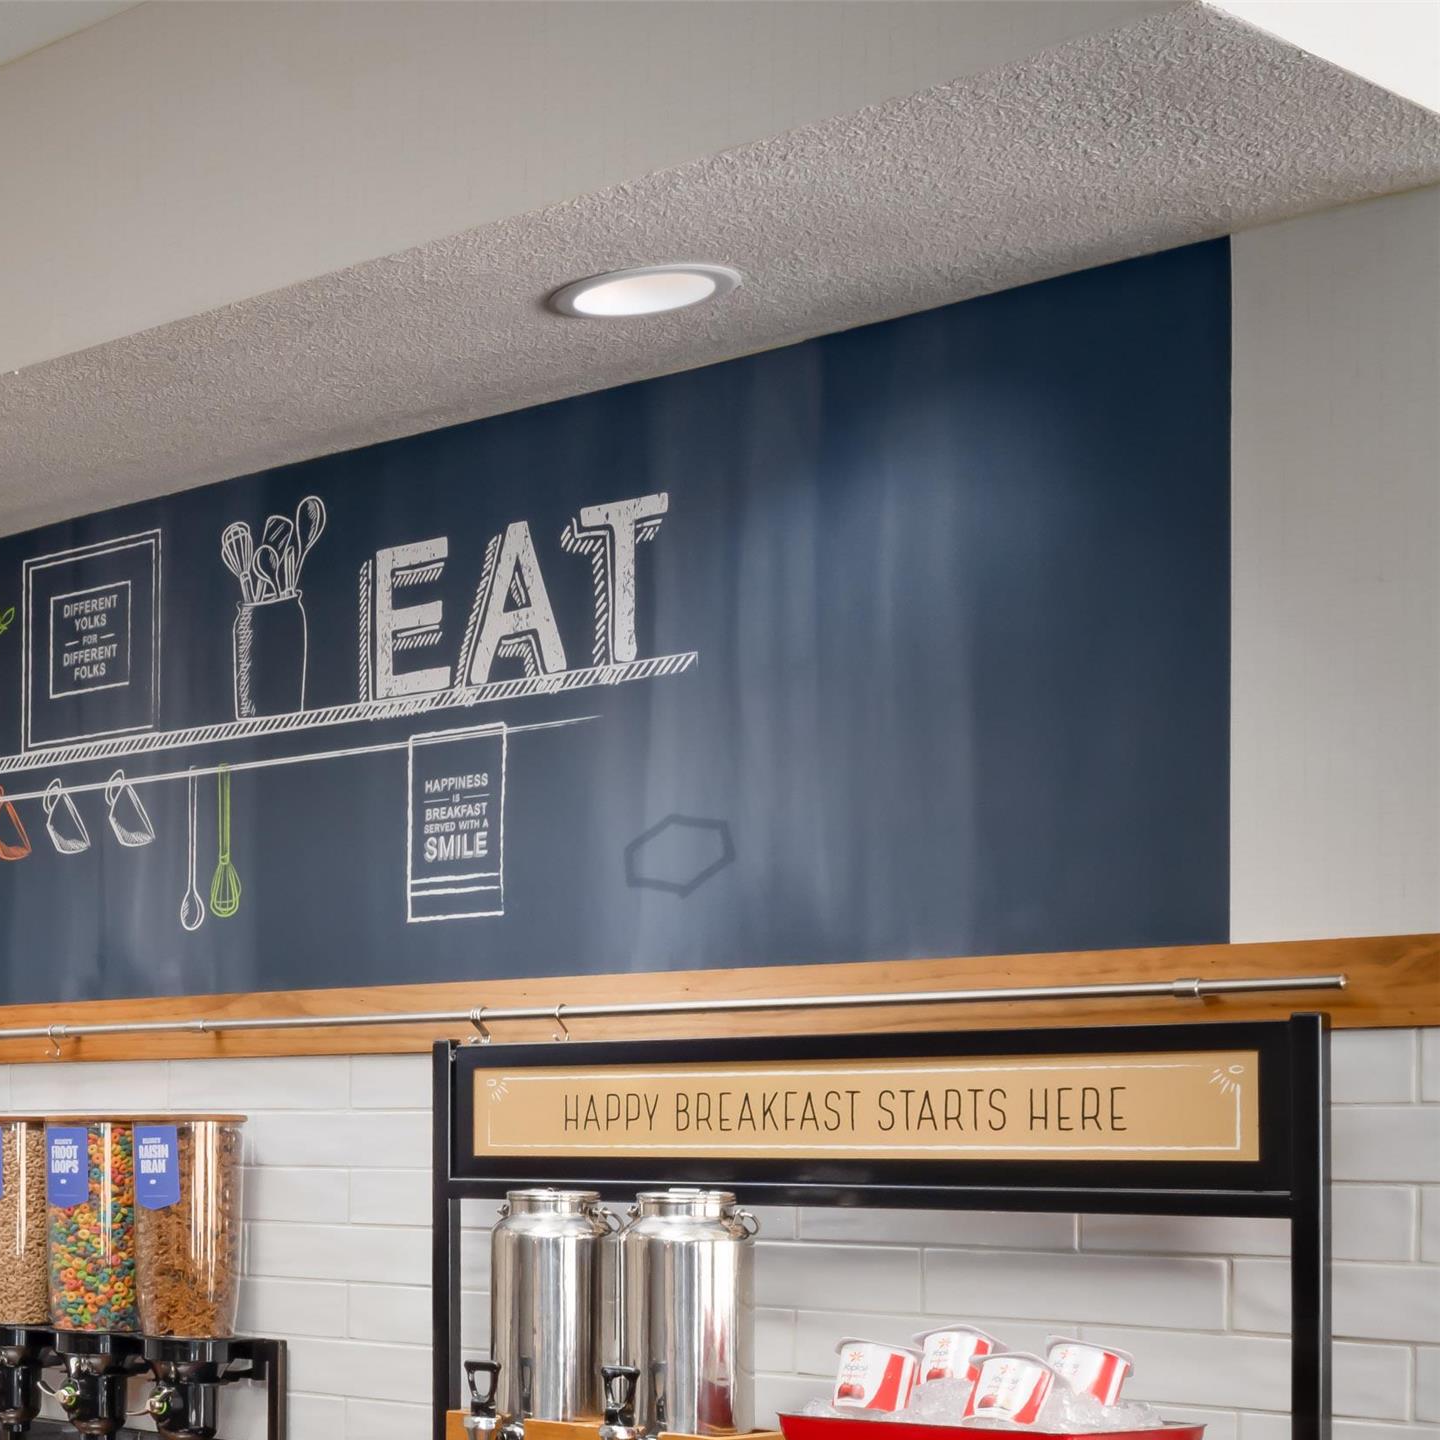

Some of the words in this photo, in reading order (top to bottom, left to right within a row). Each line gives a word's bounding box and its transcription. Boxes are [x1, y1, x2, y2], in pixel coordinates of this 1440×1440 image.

[63, 594, 118, 618] DIFFERENT
[360, 492, 669, 702] EAT
[74, 613, 107, 632] YOLKS
[82, 633, 98, 646] FOR
[63, 643, 118, 667] DIFFERENT
[73, 662, 106, 681] FOLKS
[424, 772, 489, 794] HAPPINESS
[452, 793, 460, 803] IS
[424, 802, 488, 822] BREAKFAST
[424, 821, 456, 835] SERVED
[458, 820, 480, 830] WITH
[482, 820, 489, 828] A
[423, 831, 489, 863] SMILE
[564, 1092, 659, 1132] HAPPY
[675, 1090, 861, 1132] BREAKFAST
[877, 1088, 1007, 1132] STARTS
[1029, 1086, 1127, 1131] HERE
[51, 1145, 79, 1160] FROOT
[138, 1144, 169, 1159] RAISIN
[51, 1159, 79, 1174] LOOPS
[140, 1159, 167, 1174] BRAN
